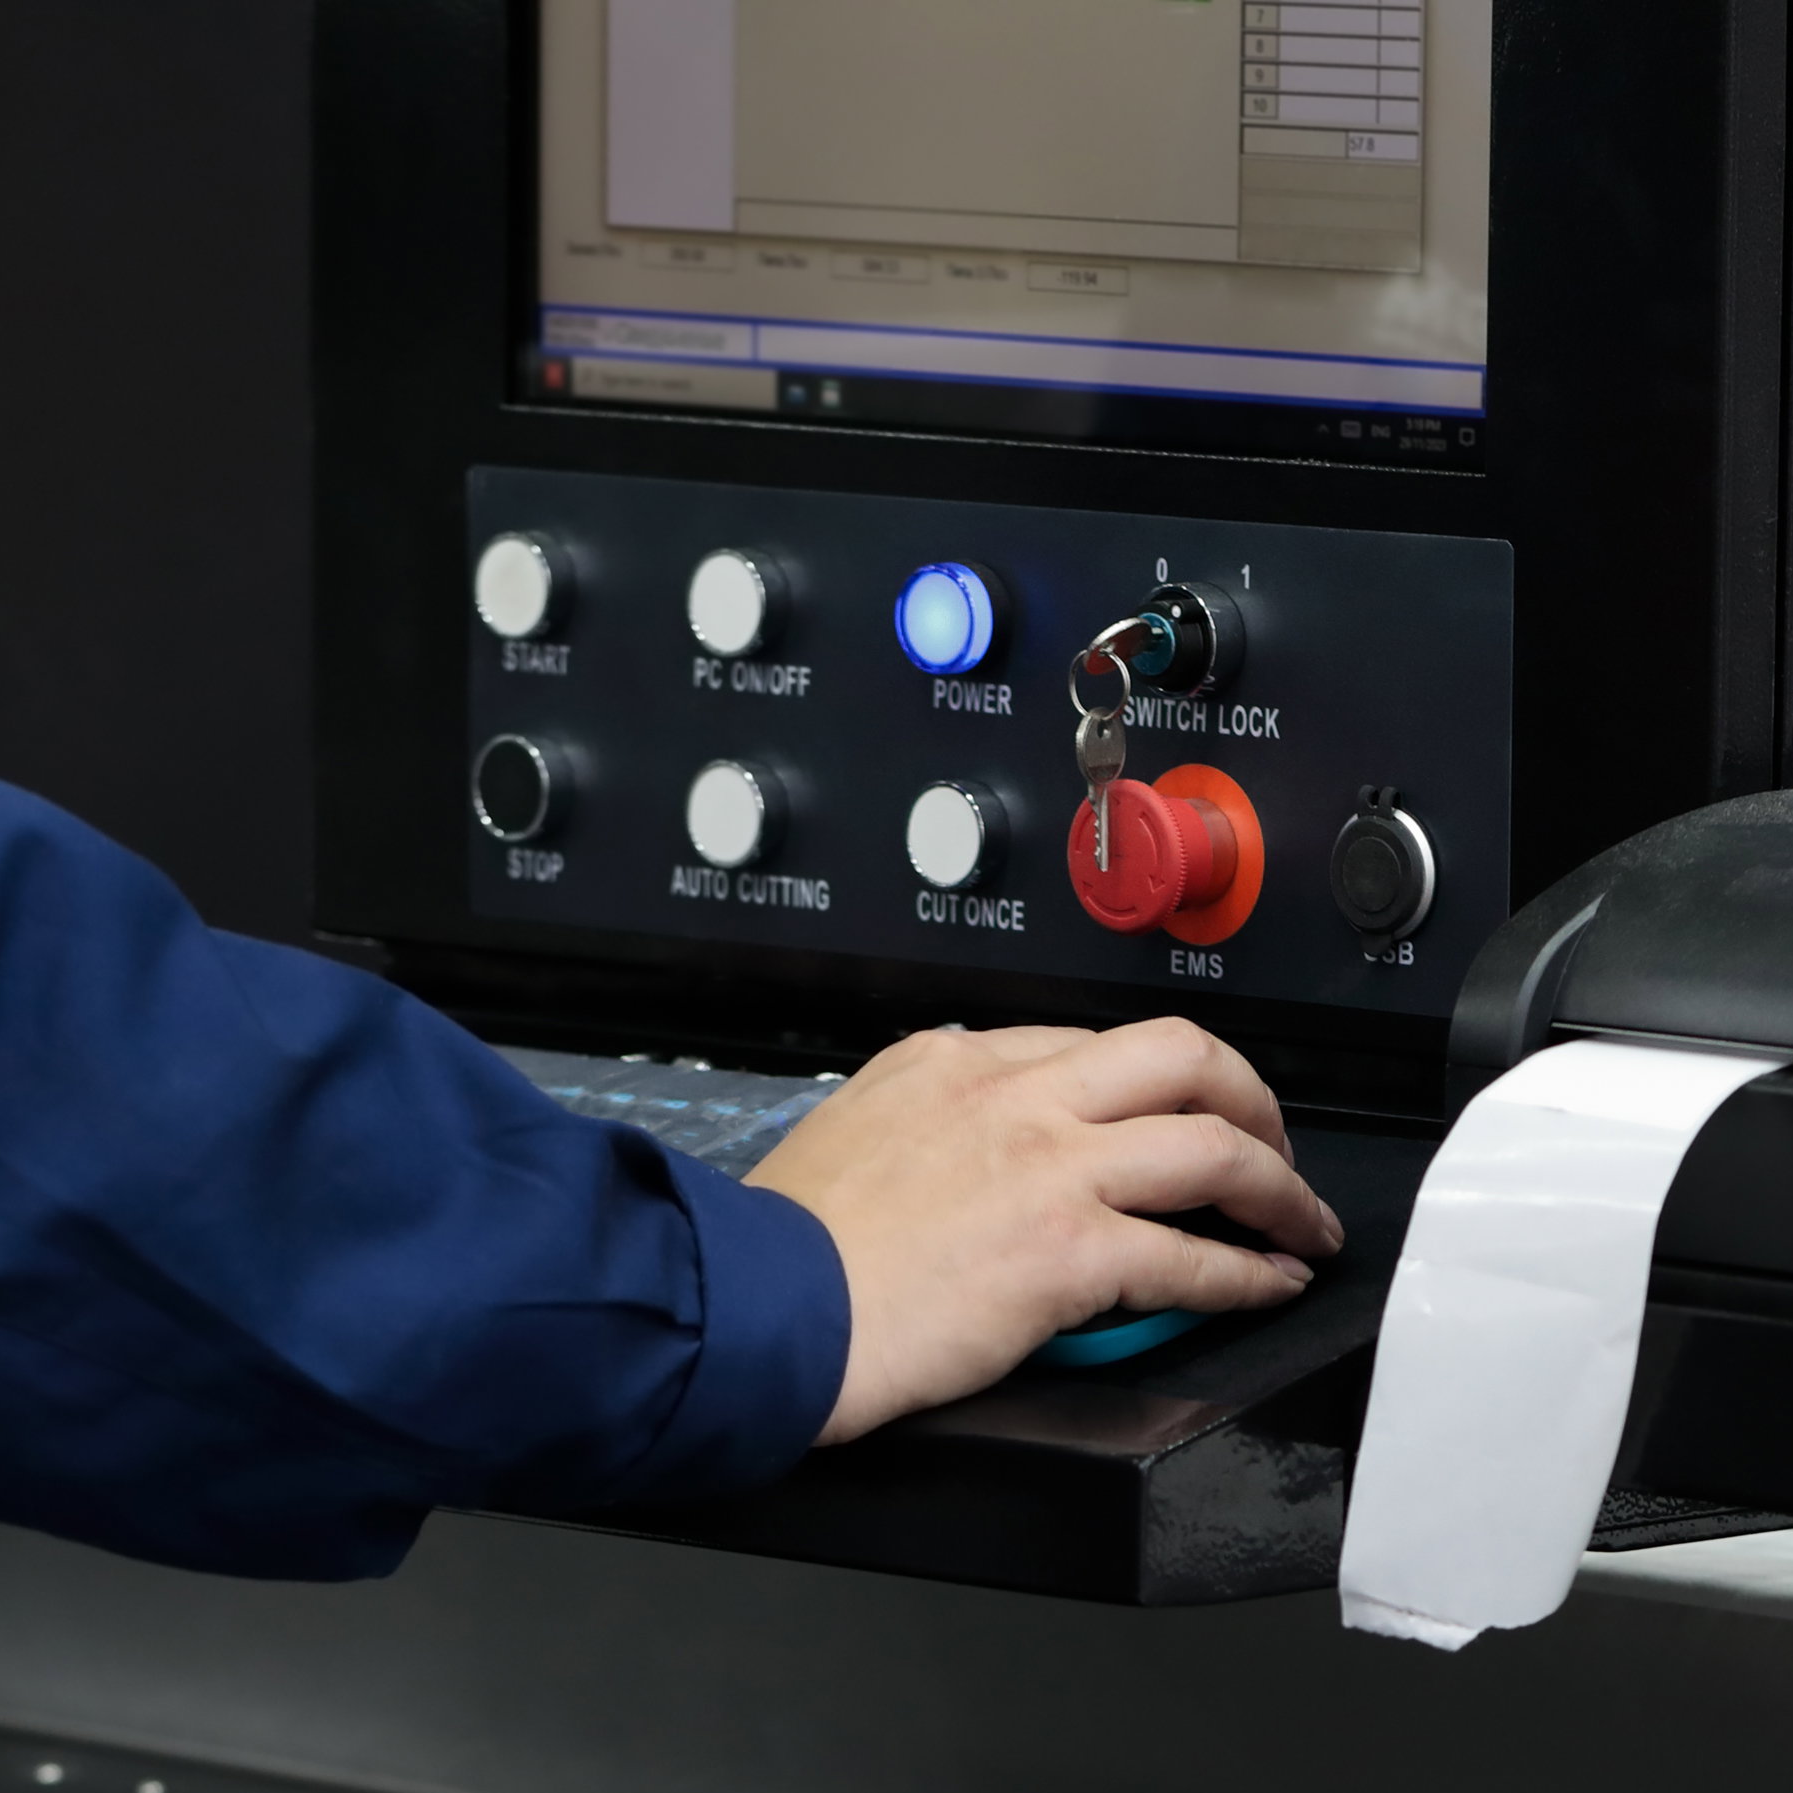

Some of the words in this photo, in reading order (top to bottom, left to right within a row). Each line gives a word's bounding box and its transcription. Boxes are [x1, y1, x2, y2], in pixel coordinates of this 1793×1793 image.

[1257, 9, 1265, 23] 7
[1253, 98, 1268, 113] 10
[1156, 557, 1168, 582] 0
[1241, 564, 1250, 590] 1
[501, 640, 570, 676] START
[693, 657, 722, 689] PC
[731, 661, 812, 697] ON/OFF
[932, 678, 1013, 716] POWER
[1122, 697, 1207, 733] SWITCH
[1218, 704, 1281, 740] LOCK
[507, 848, 564, 883] STOP
[670, 865, 729, 900] AUTO
[737, 873, 831, 912] CUTTING
[916, 890, 959, 924] CUT
[963, 896, 1025, 931] ONCE
[1170, 949, 1224, 979] EMS
[1363, 940, 1415, 966] SB
